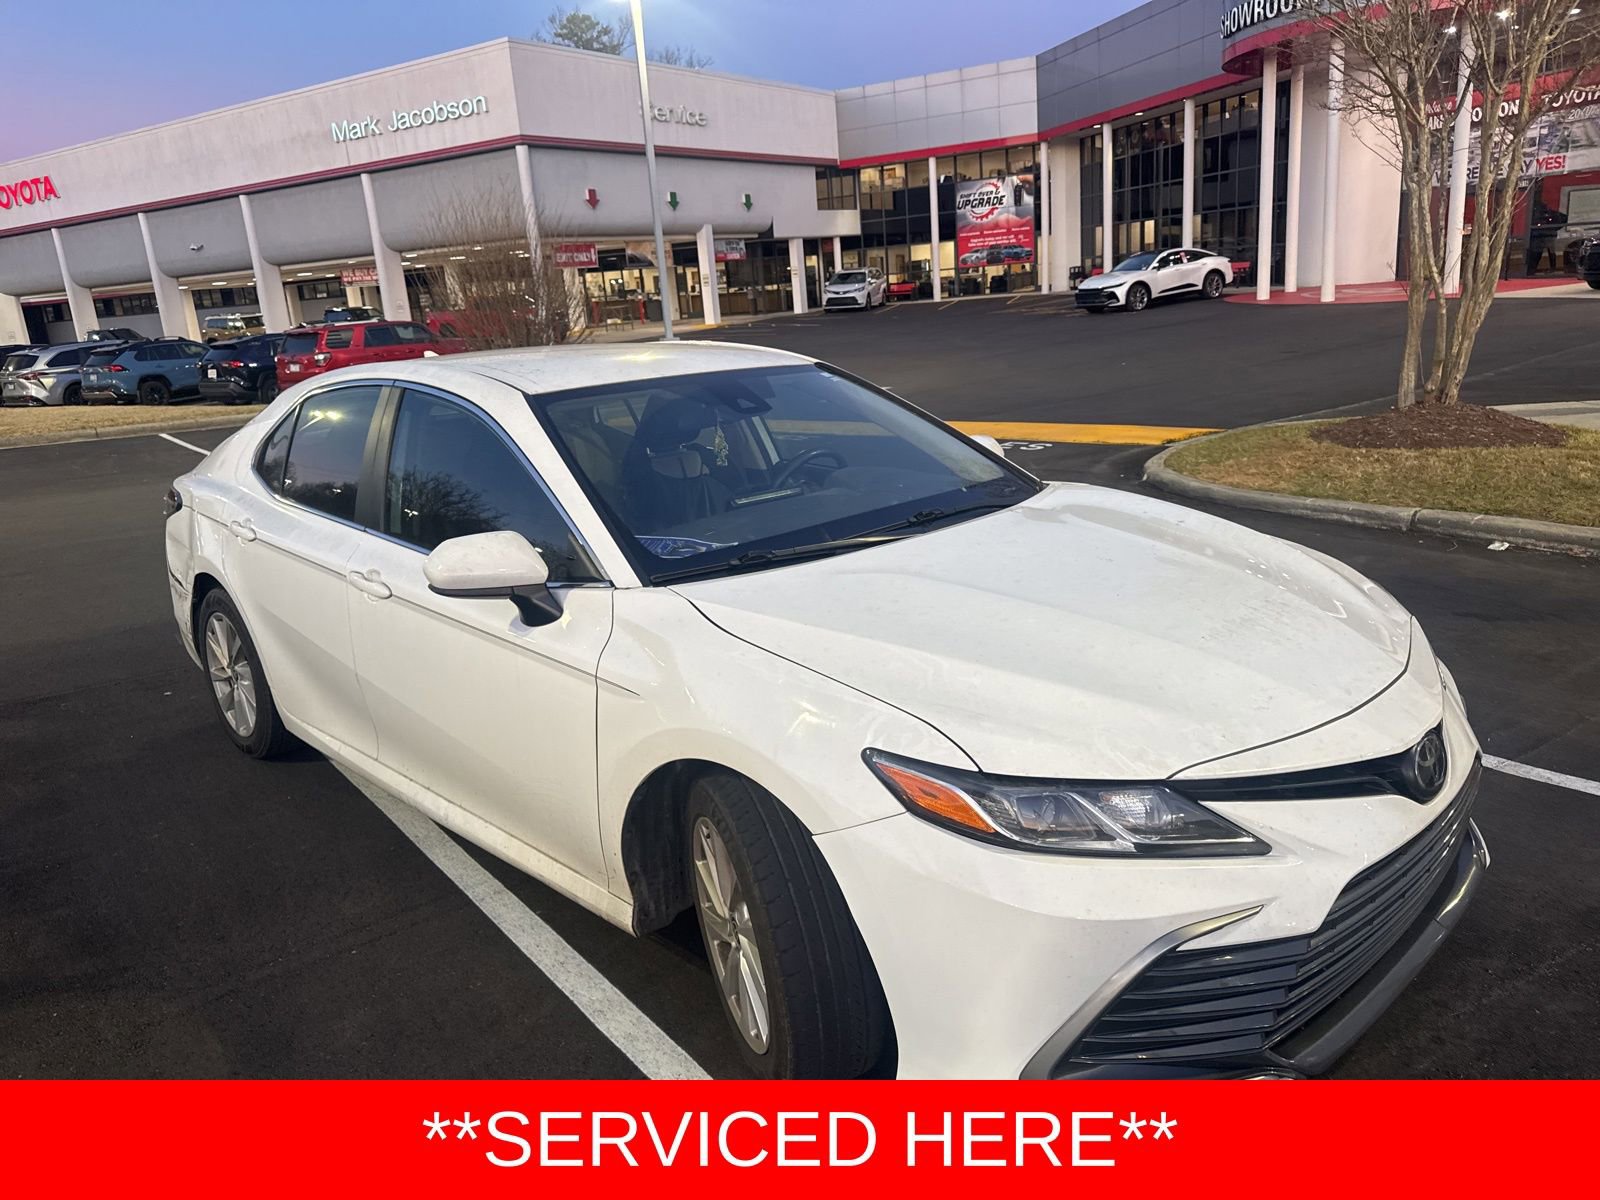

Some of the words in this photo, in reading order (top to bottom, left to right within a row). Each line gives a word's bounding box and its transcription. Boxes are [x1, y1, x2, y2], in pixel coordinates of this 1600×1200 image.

[1220, 0, 1310, 39] SHOWRO
[331, 115, 382, 143] Mark
[388, 95, 489, 132] Jacobson
[639, 100, 707, 127] ervice
[1536, 155, 1567, 171] YES!
[0, 175, 60, 209] OYOTA
[957, 195, 1006, 210] UPGRADE
